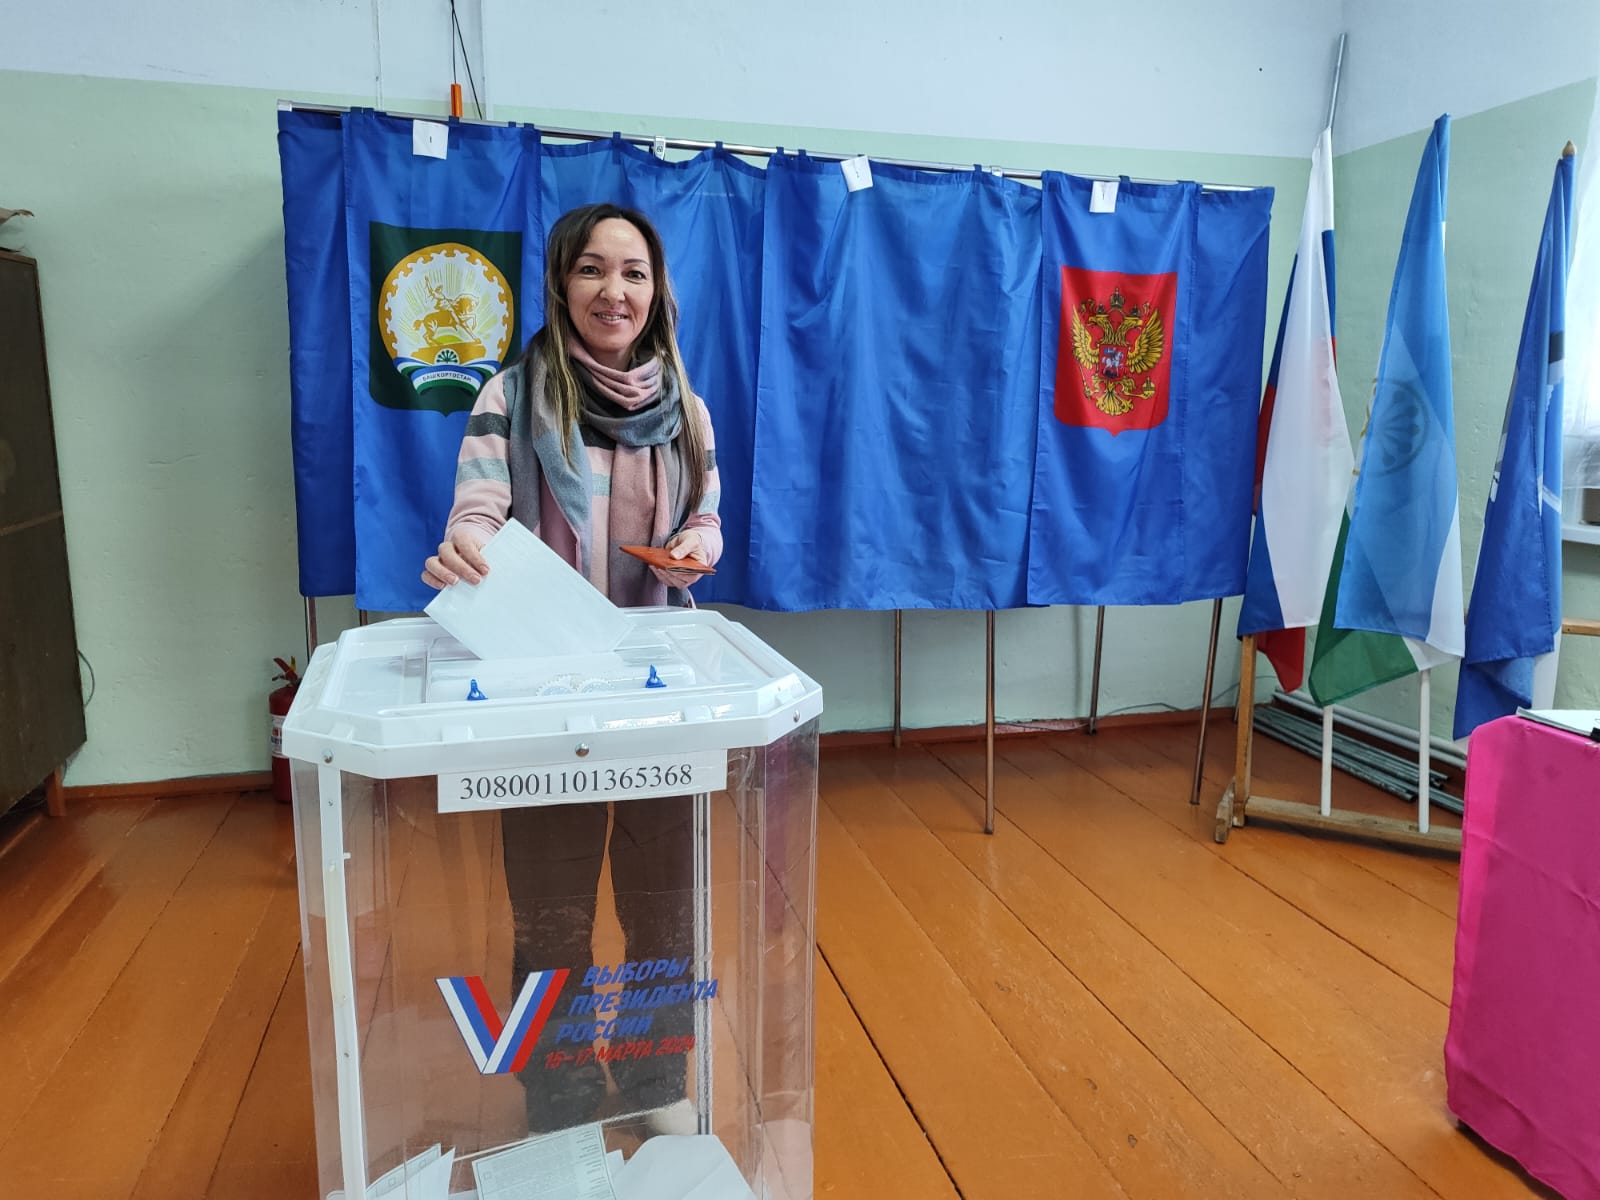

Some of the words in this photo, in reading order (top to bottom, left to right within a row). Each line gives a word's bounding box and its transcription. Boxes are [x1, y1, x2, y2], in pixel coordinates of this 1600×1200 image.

[460, 763, 692, 800] 308001101365368
[581, 956, 690, 988] ВЫБОРЫ
[567, 978, 719, 1017] ПРЕЗИДЕНТА
[554, 1014, 655, 1045] РОССИИ
[595, 1040, 653, 1064] МАРТА
